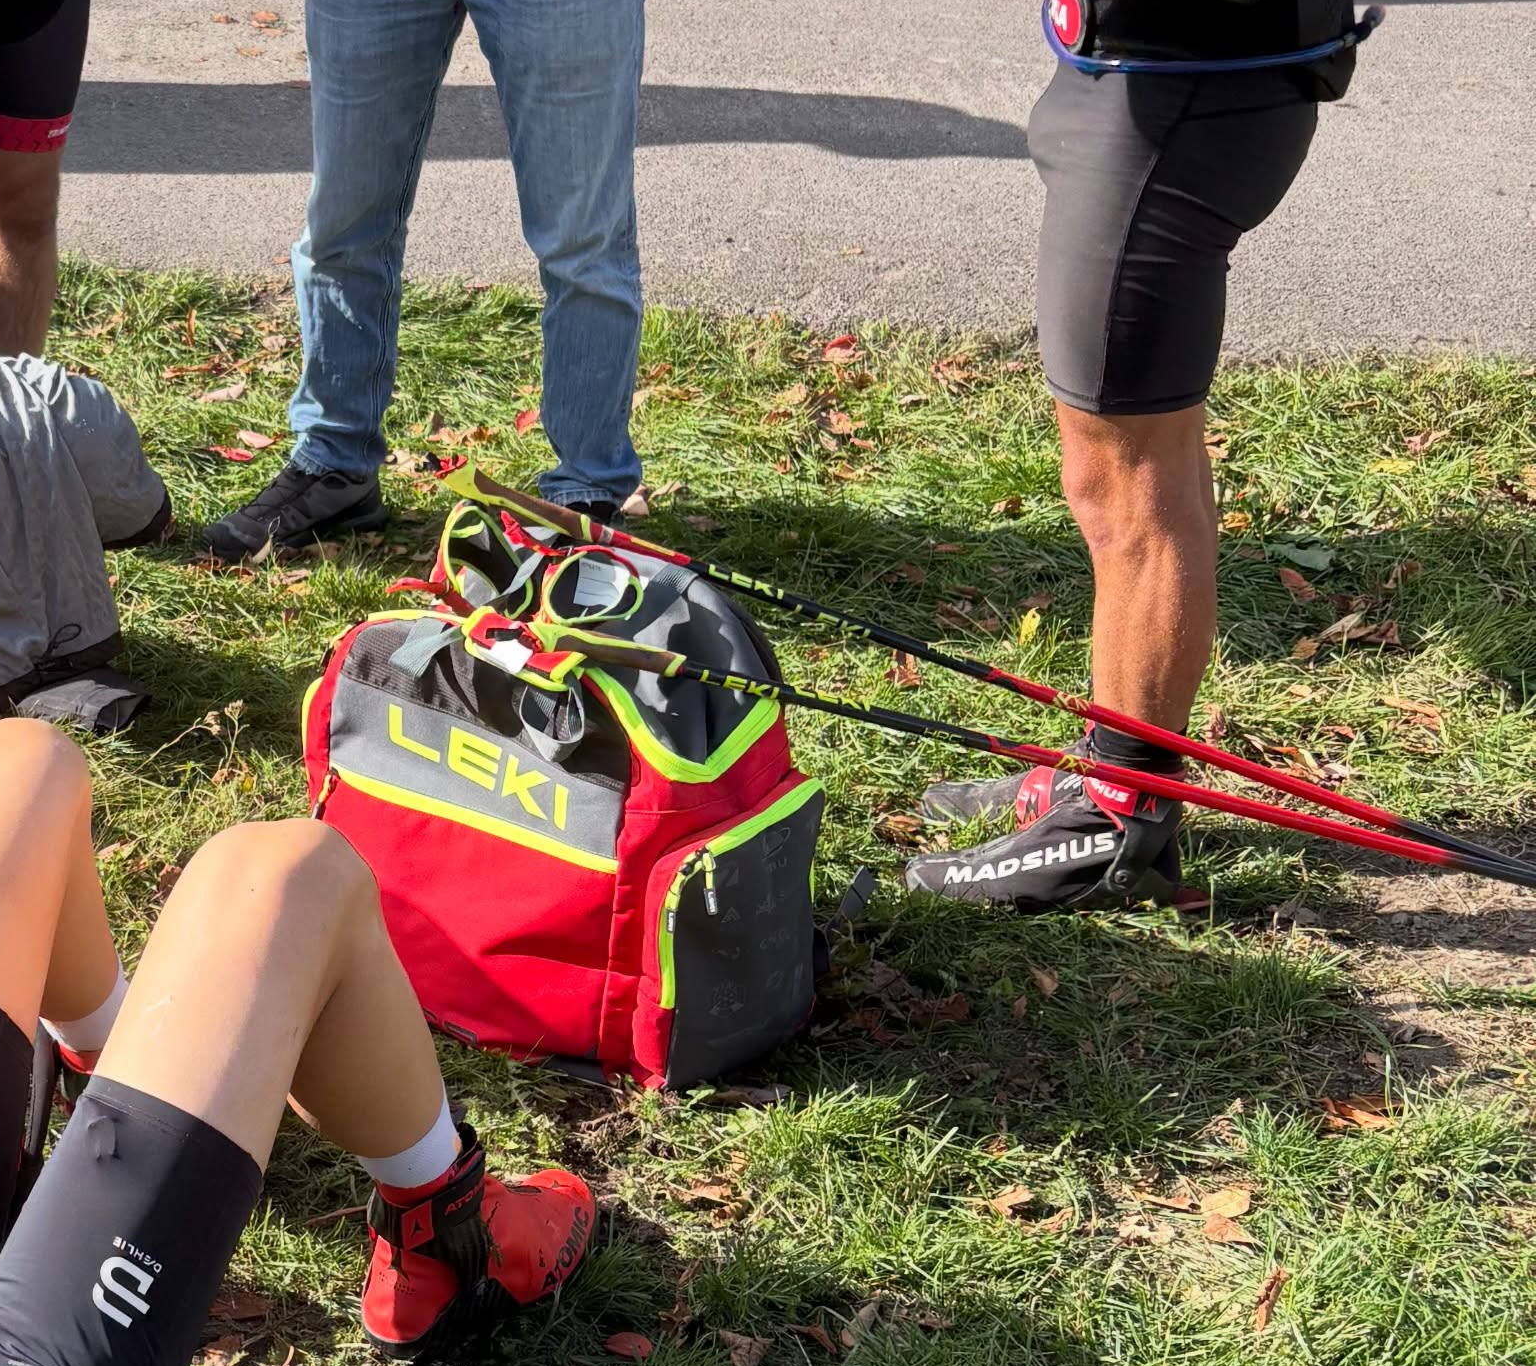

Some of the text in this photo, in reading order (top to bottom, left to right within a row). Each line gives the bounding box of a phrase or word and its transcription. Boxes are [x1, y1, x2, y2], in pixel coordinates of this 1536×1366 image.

[709, 563, 784, 600] LEKI
[699, 669, 872, 712] LEKI LEKI
[388, 703, 569, 832] LEKI
[944, 831, 1115, 886] MADSHUS
[541, 1206, 590, 1291] ATOMIC
